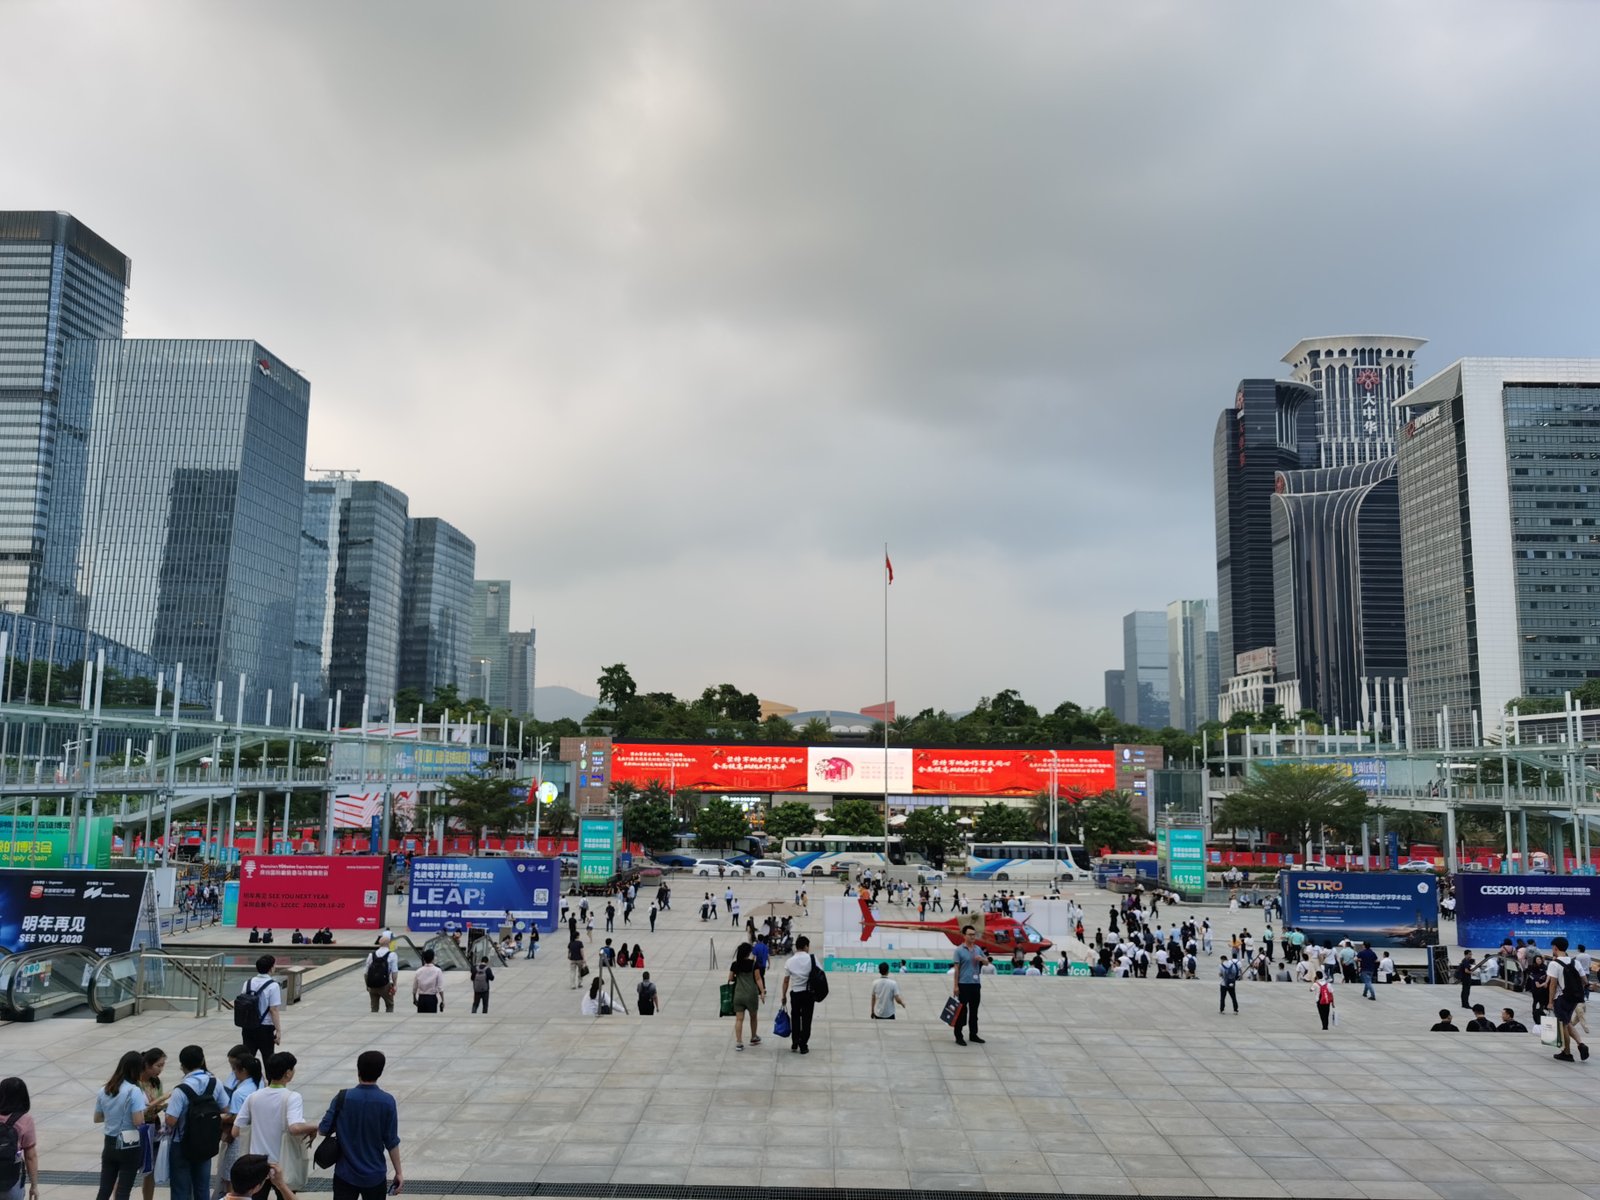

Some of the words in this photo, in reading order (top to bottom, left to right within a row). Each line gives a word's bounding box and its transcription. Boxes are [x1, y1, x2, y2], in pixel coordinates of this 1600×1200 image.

[1362, 392, 1377, 435] 大中华
[1297, 880, 1343, 891] CSTRO
[1480, 886, 1526, 895] CESE2019
[412, 888, 480, 905] LEAP
[1507, 903, 1565, 915] 明年再相见
[22, 915, 86, 932] 明年再见
[19, 934, 36, 942] SEE
[38, 934, 58, 942] YOU
[60, 935, 83, 943] 2020
